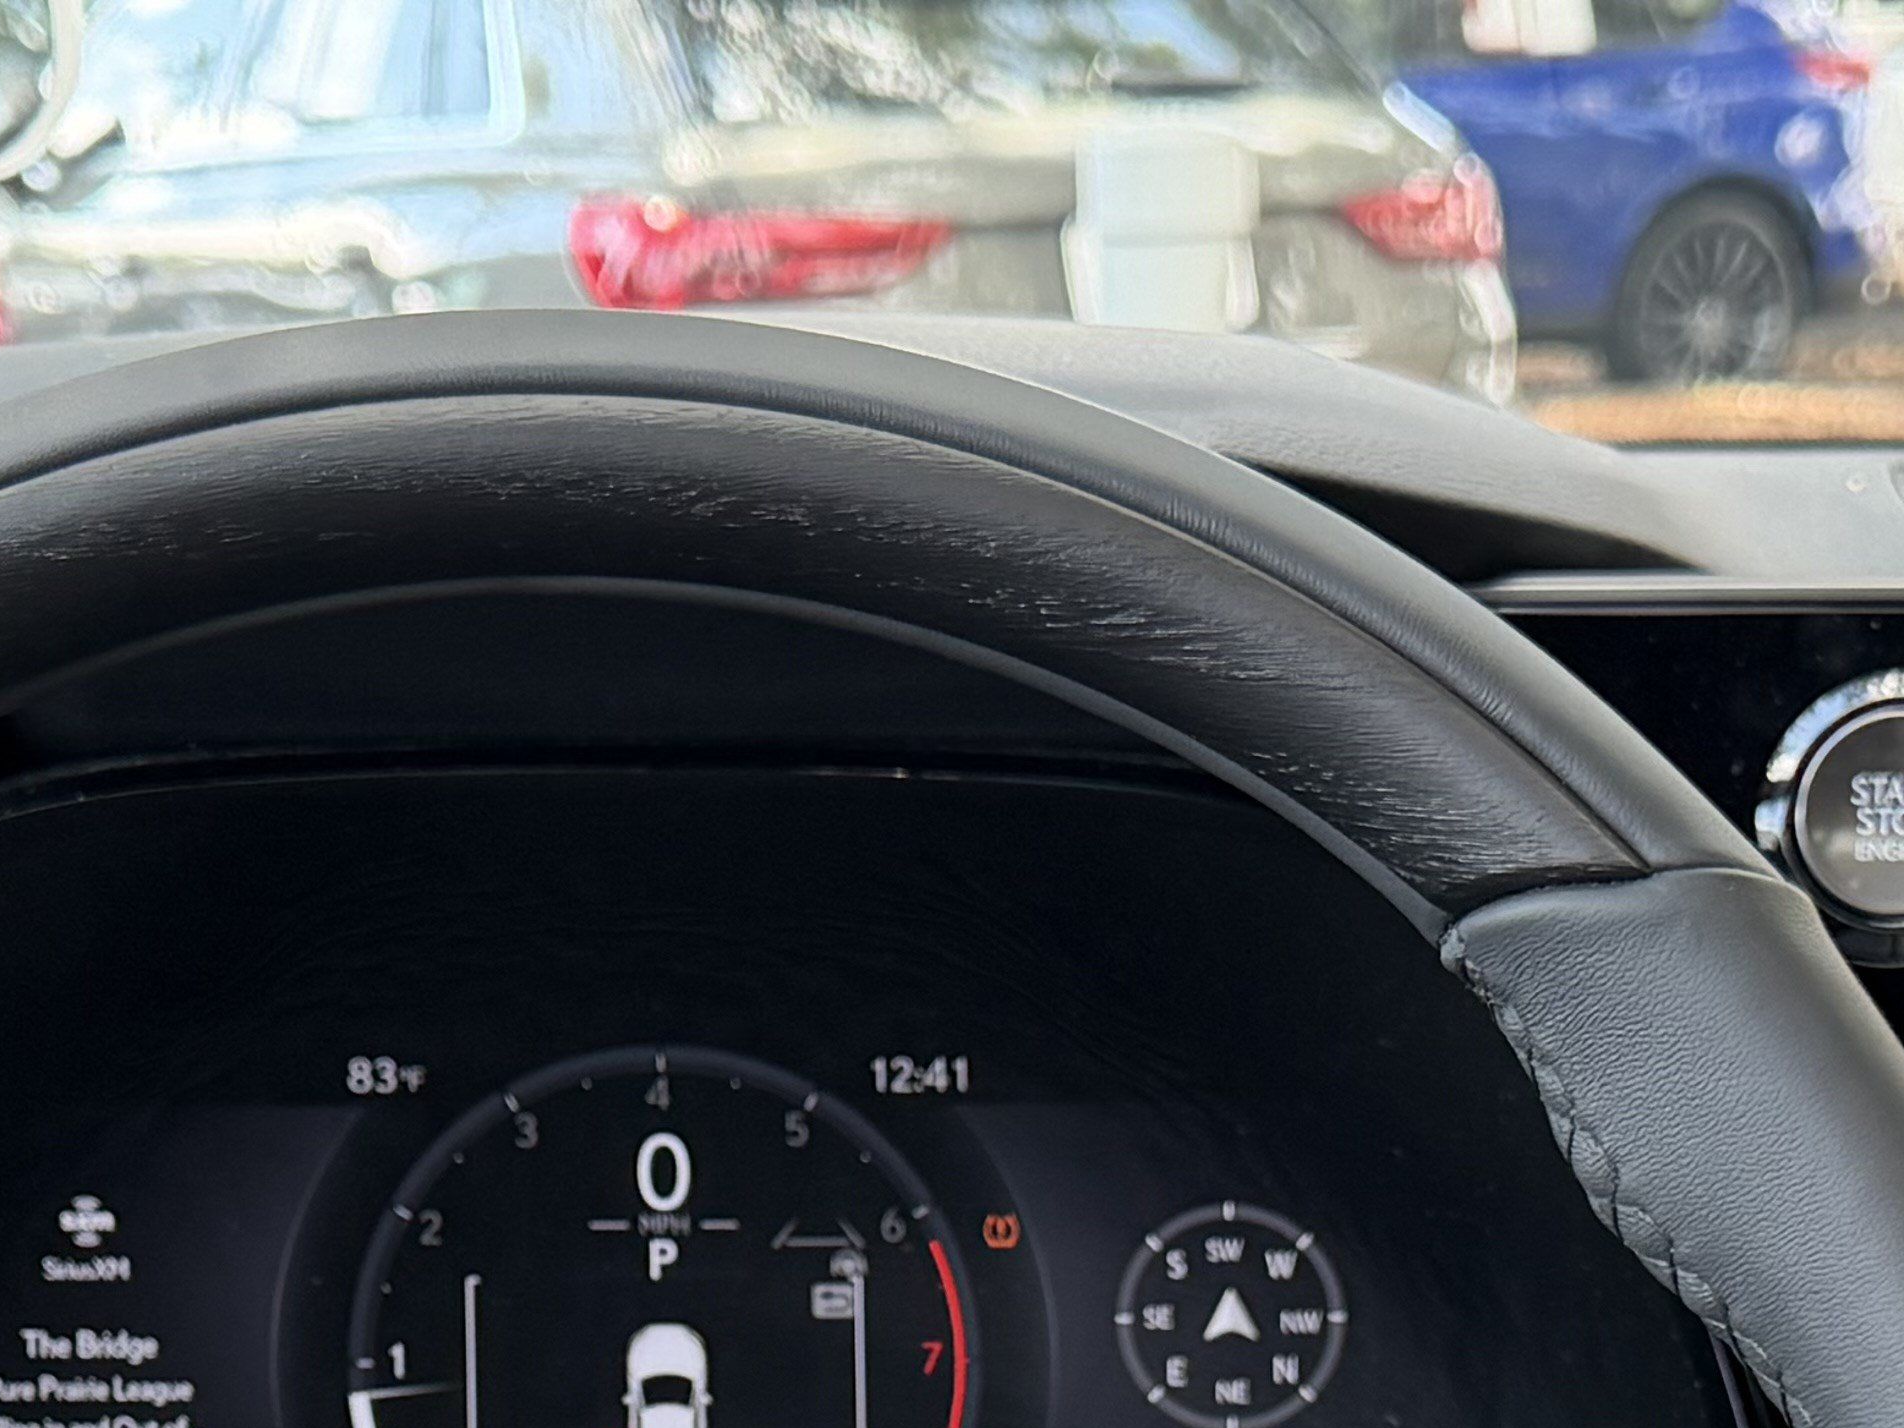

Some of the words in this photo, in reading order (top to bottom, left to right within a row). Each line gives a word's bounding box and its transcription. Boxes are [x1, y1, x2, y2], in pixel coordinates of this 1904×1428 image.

[870, 1055, 969, 1093] 12:41
[645, 1075, 670, 1111] 4
[514, 1111, 538, 1149] 3
[785, 1110, 810, 1148] 5
[636, 1131, 691, 1212] 0
[418, 1208, 444, 1247] 2
[881, 1208, 907, 1243] 6
[648, 1237, 679, 1283] P
[1165, 1249, 1189, 1281] S
[1204, 1236, 1245, 1263] SW
[1264, 1249, 1298, 1281] W
[1142, 1303, 1176, 1331] SE
[1279, 1308, 1323, 1335] NW
[20, 1328, 73, 1359] The
[75, 1328, 159, 1365] Bridge
[387, 1340, 406, 1380] 1
[921, 1341, 944, 1376] 7
[1166, 1355, 1188, 1388] E
[1272, 1353, 1299, 1385] N
[38, 1373, 110, 1402] Prairie
[112, 1374, 194, 1408] League
[1214, 1377, 1251, 1405] NE
